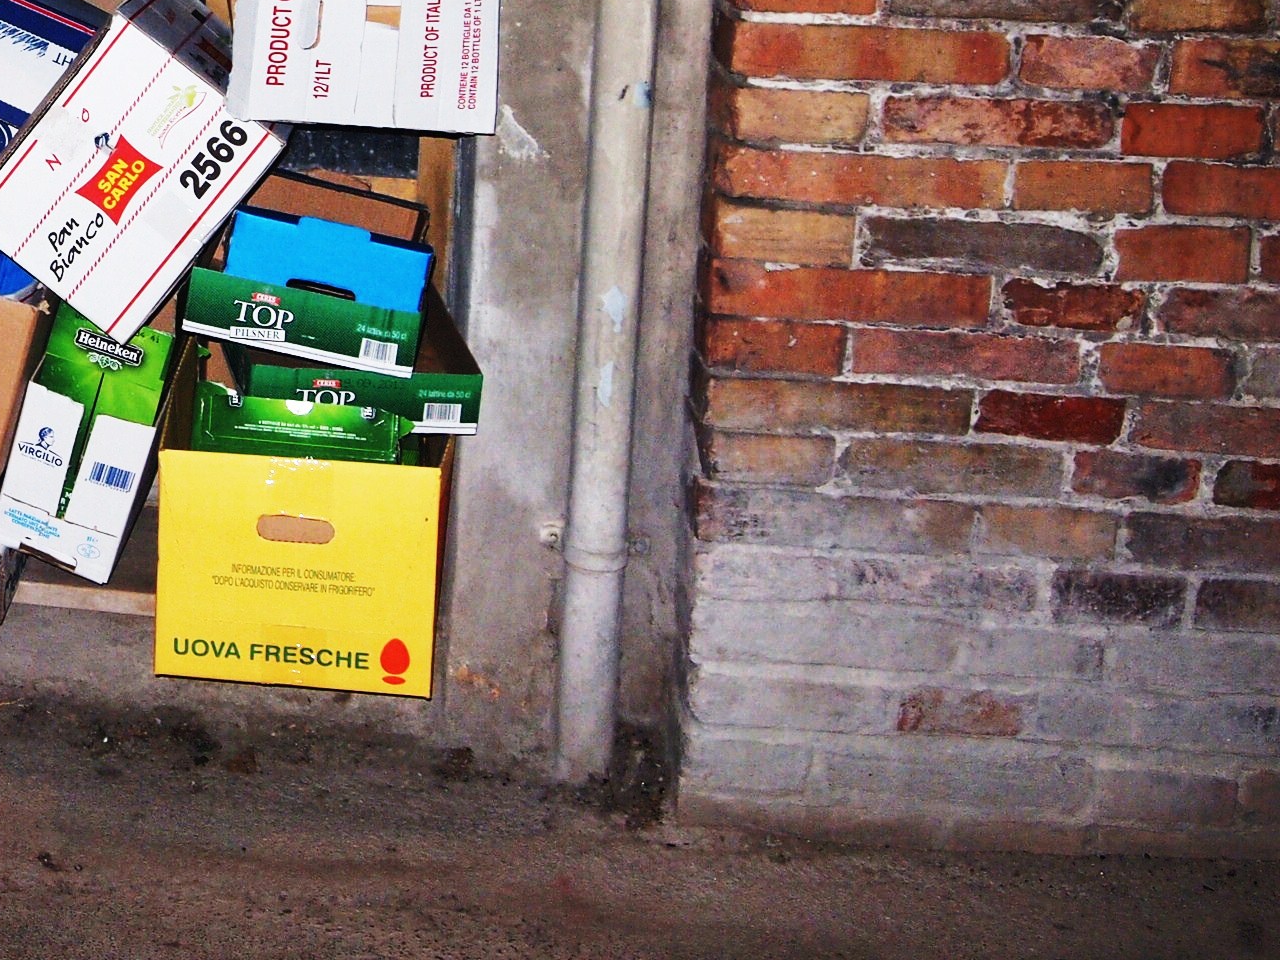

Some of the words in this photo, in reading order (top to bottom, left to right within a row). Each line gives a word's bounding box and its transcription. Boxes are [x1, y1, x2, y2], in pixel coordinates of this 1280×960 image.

[464, 7, 472, 18] DA
[474, 16, 481, 26] OF
[266, 4, 293, 86] PRODUCT
[425, 26, 439, 42] OF
[462, 21, 472, 60] BOTTIGLIE
[472, 28, 481, 64] BOTTLES
[420, 43, 438, 98] PRODUCT
[471, 65, 479, 73] 12
[457, 72, 468, 110] CONTIENE
[468, 76, 478, 110] CONTAIN
[179, 120, 248, 200] 2566
[97, 158, 129, 193] SAN
[103, 159, 145, 210] CARLO
[47, 217, 80, 253] Pan
[234, 299, 294, 330] TOP
[235, 328, 280, 340] PILSNER
[356, 324, 366, 332] 24
[391, 330, 400, 339] 50
[77, 332, 140, 362] Heineken
[296, 389, 355, 406] TOP
[419, 390, 427, 398] 24
[18, 443, 64, 467] VIRGILIO
[231, 563, 281, 577] INFORMAZIONE
[282, 568, 295, 578] PER
[297, 569, 302, 579] IL
[234, 577, 274, 590] L'ACQUISTO
[275, 580, 319, 593] CONSERVARE
[320, 585, 327, 594] IN
[173, 638, 241, 659] UOVA
[249, 643, 370, 669] FRESCHE
